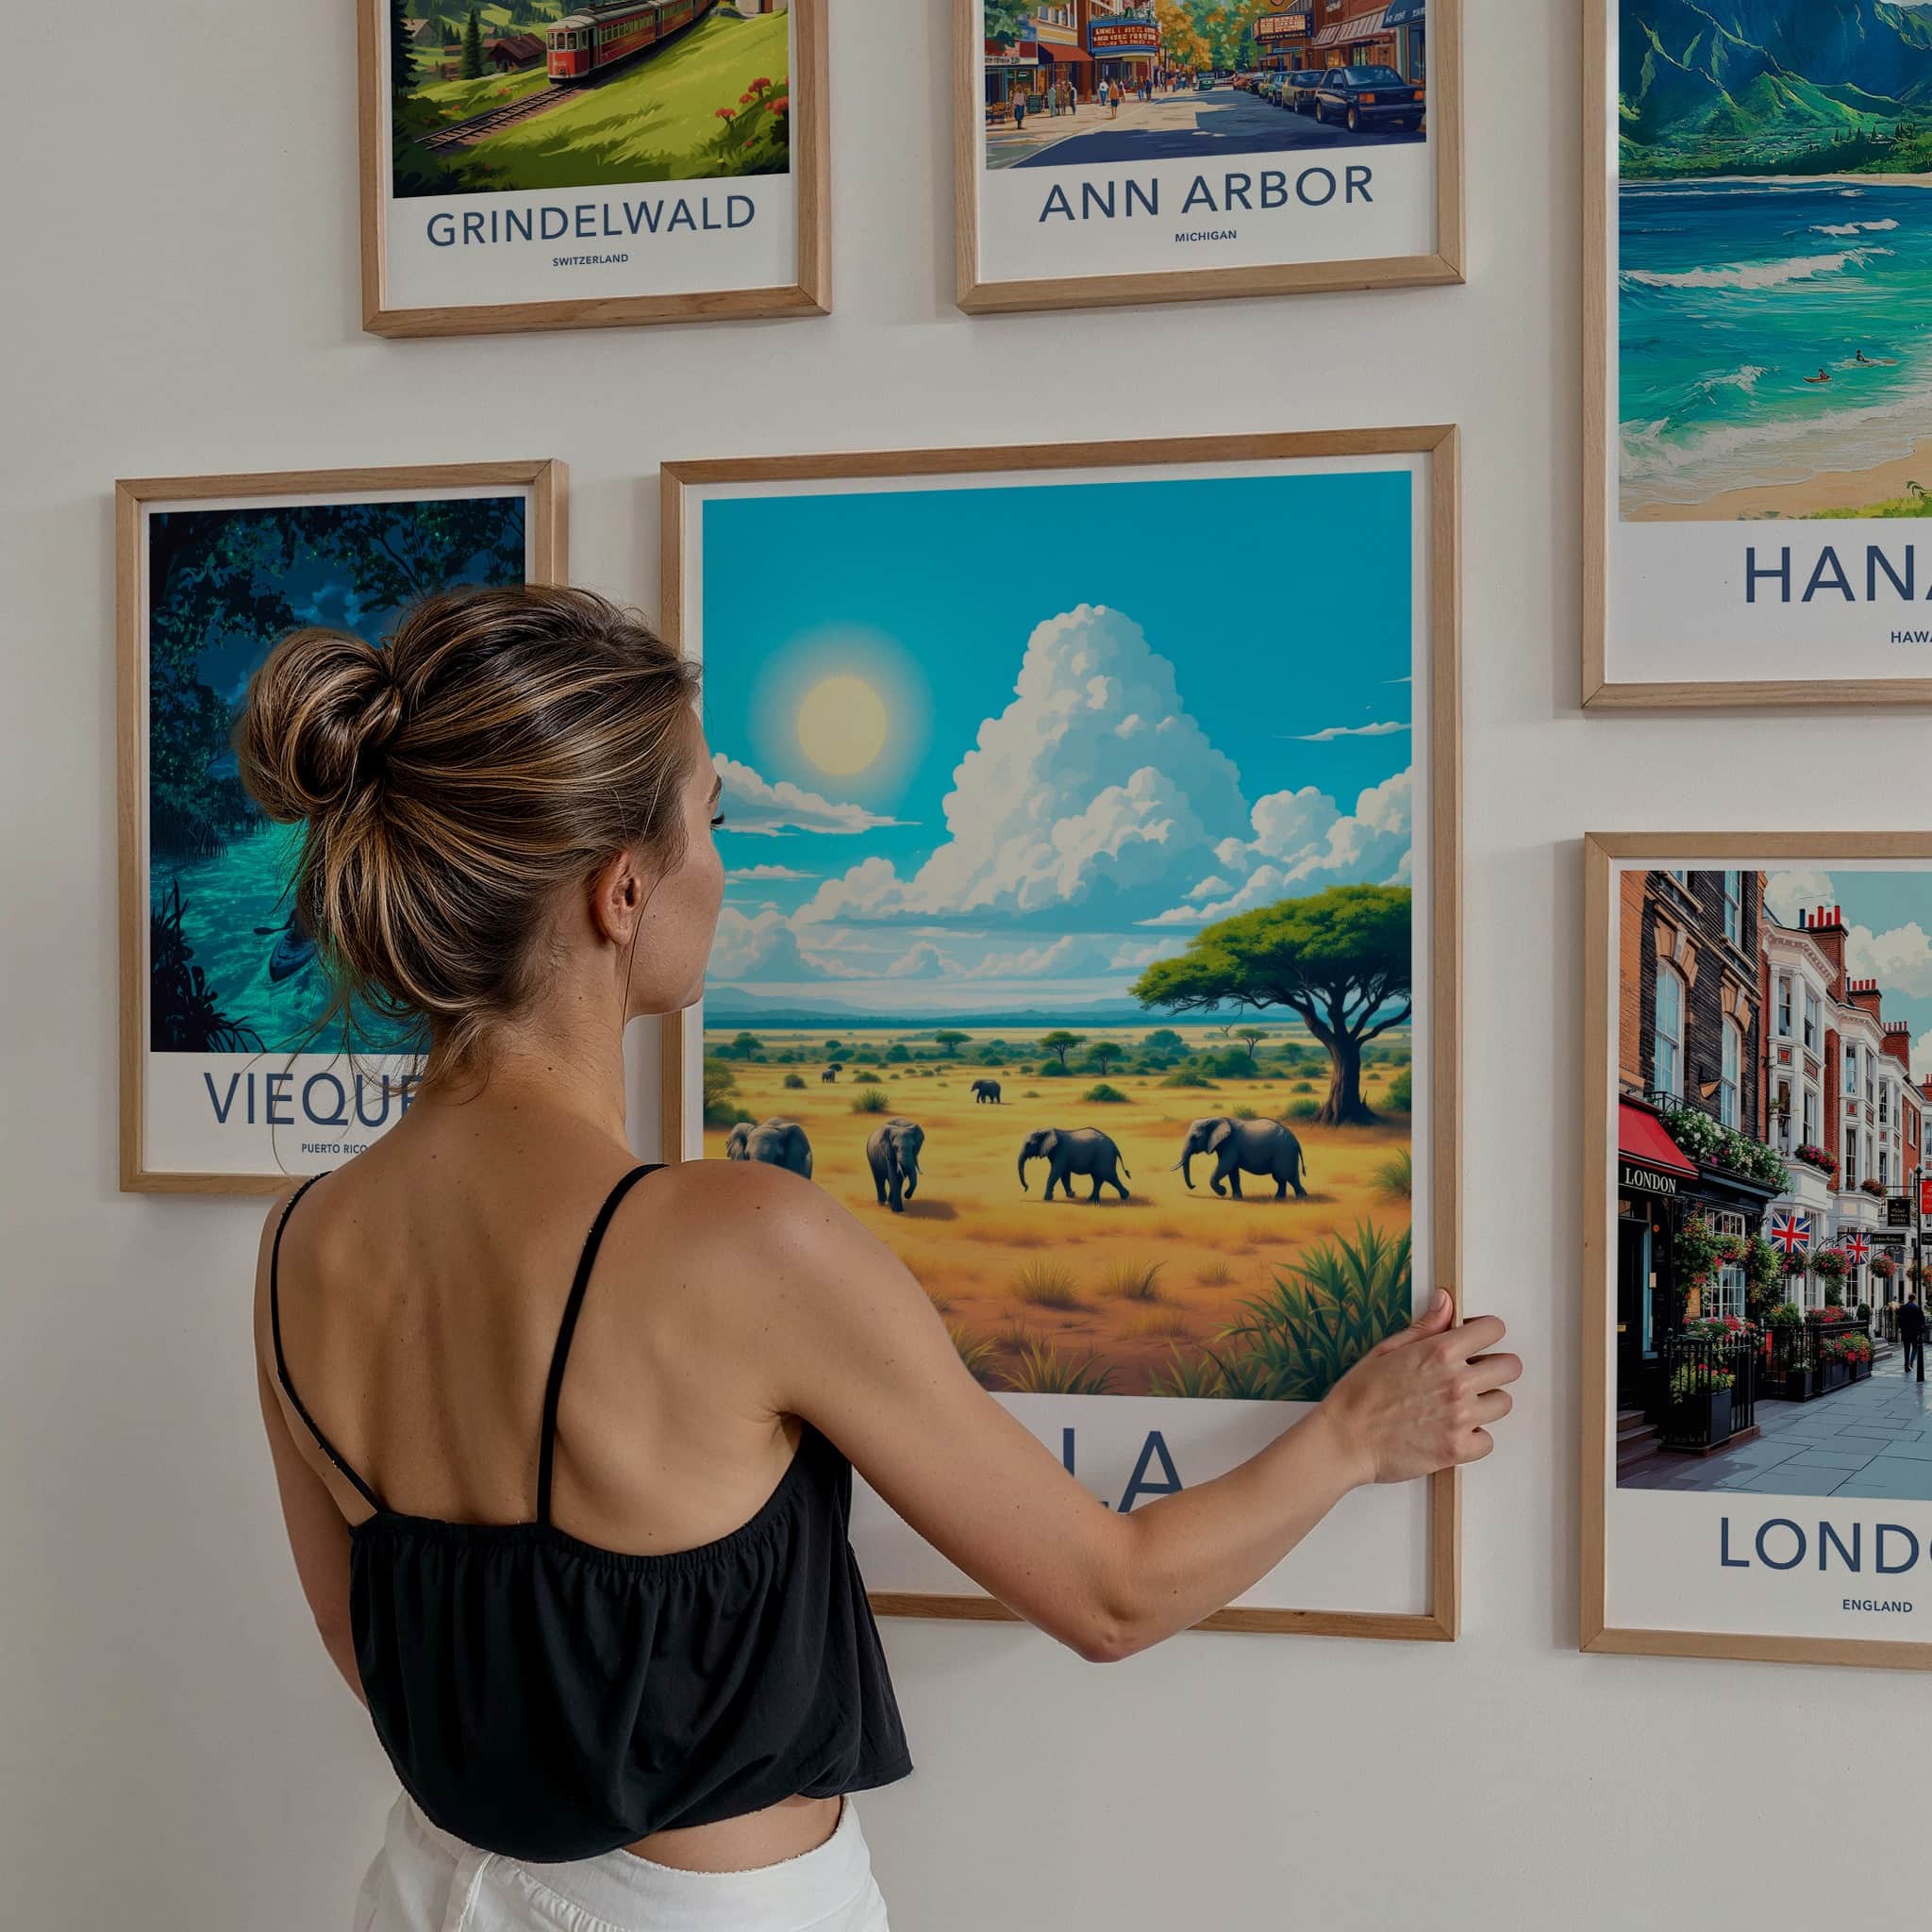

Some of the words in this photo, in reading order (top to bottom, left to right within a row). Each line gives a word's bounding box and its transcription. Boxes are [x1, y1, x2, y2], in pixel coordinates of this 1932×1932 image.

[1039, 177, 1158, 223] ANN
[1181, 165, 1374, 214] ARBOR
[426, 194, 756, 247] GRINDELWALD
[1174, 229, 1237, 242] MICHIGAN
[552, 253, 629, 267] SWITZERLAND
[1747, 544, 1932, 603] HAN
[1890, 630, 1932, 643] HAW
[301, 1143, 341, 1154] PUERTO
[1624, 1167, 1676, 1194] LONDON
[1721, 1517, 1932, 1574] LOND
[1842, 1598, 1913, 1613] ENGLAND
